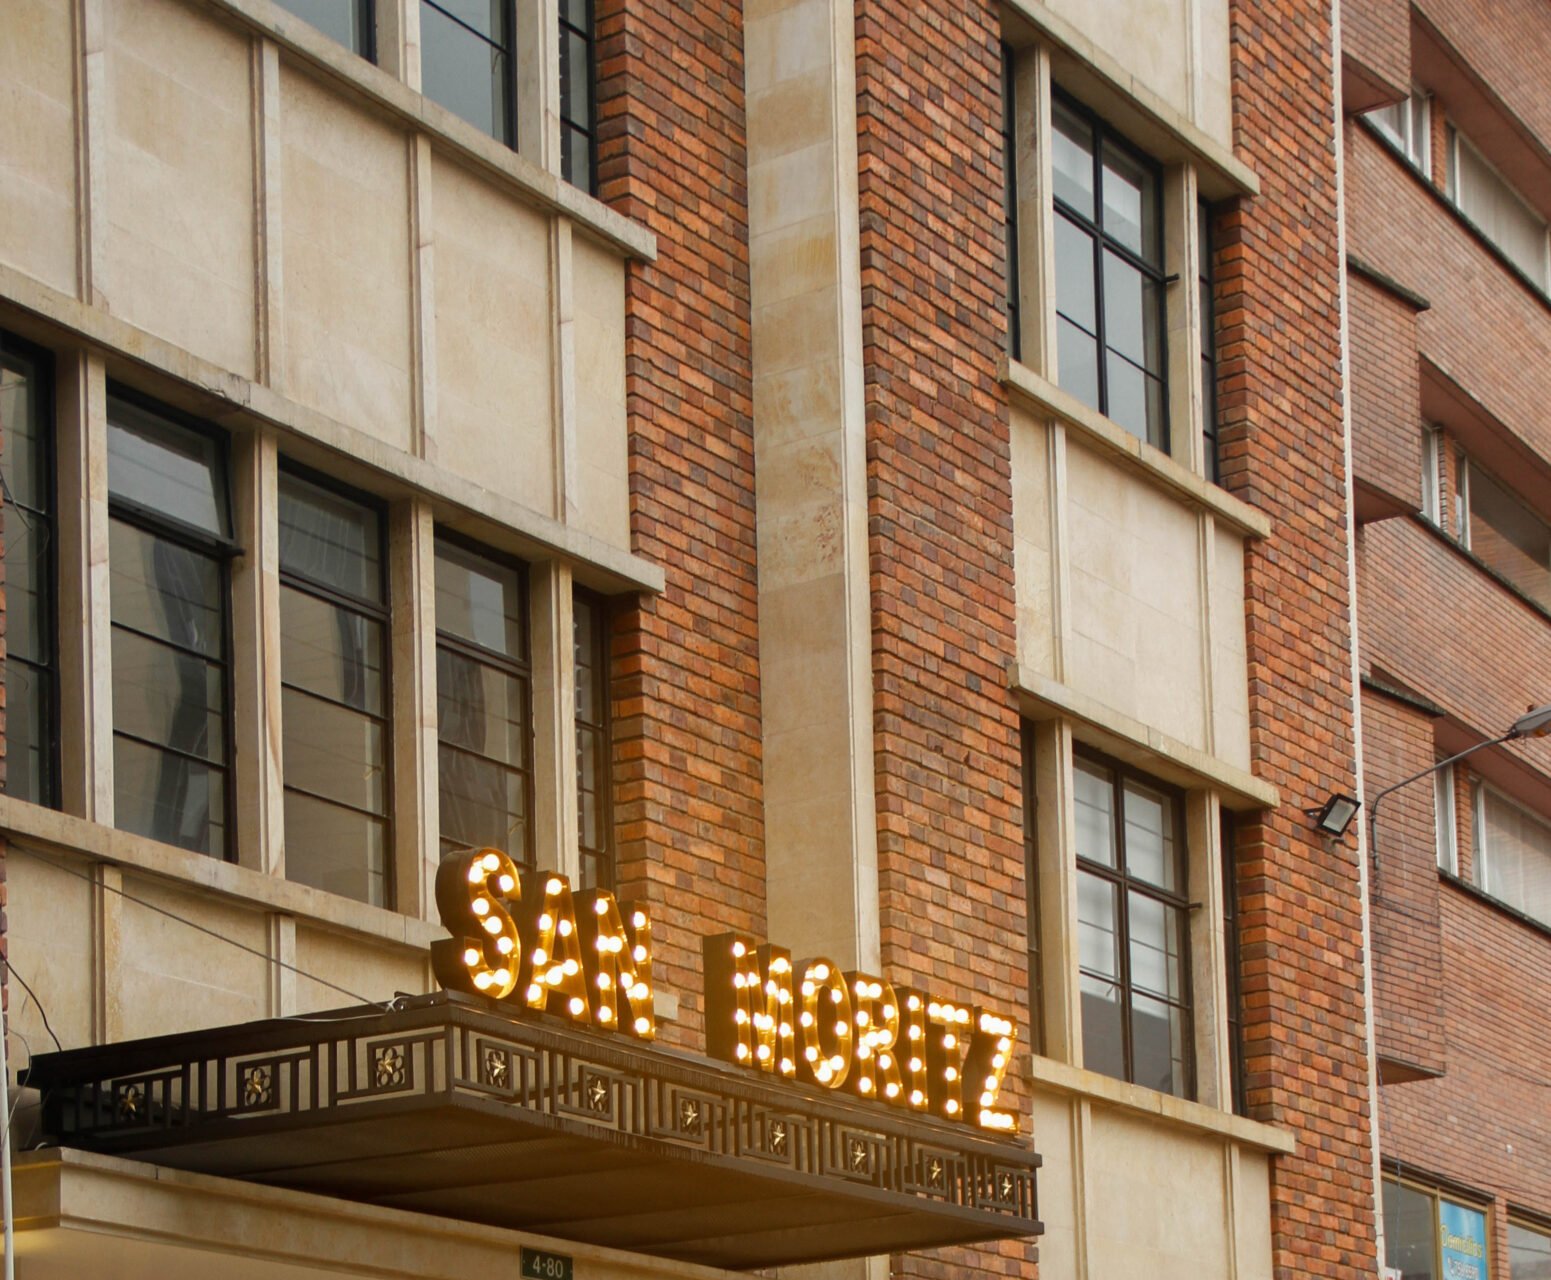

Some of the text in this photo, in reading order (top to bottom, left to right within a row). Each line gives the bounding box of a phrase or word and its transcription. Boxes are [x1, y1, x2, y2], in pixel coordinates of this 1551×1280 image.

[460, 846, 1021, 1134] SAN MORITZ
[532, 1255, 564, 1279] 4-80
